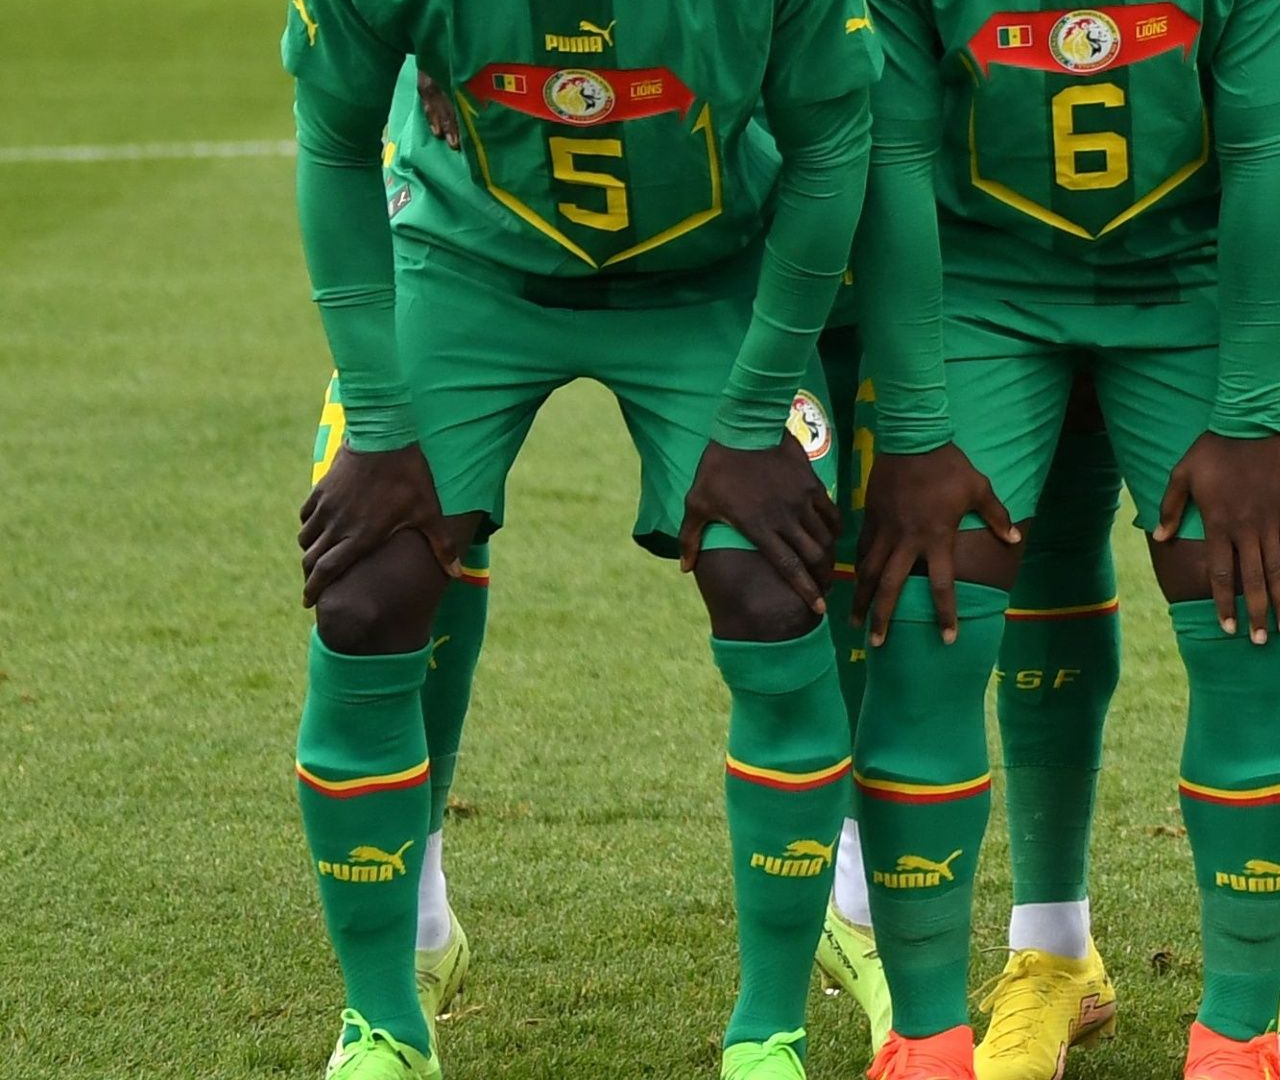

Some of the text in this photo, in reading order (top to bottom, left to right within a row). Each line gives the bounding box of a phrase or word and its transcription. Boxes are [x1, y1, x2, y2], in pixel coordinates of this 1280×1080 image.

[1136, 20, 1168, 39] LIONS
[545, 34, 603, 53] PUMA
[630, 83, 663, 97] LIONS
[1052, 83, 1128, 190] 6
[549, 137, 629, 232] 5
[319, 861, 393, 882] PUMA
[751, 853, 823, 876] PUMA
[873, 871, 940, 888] PUMA
